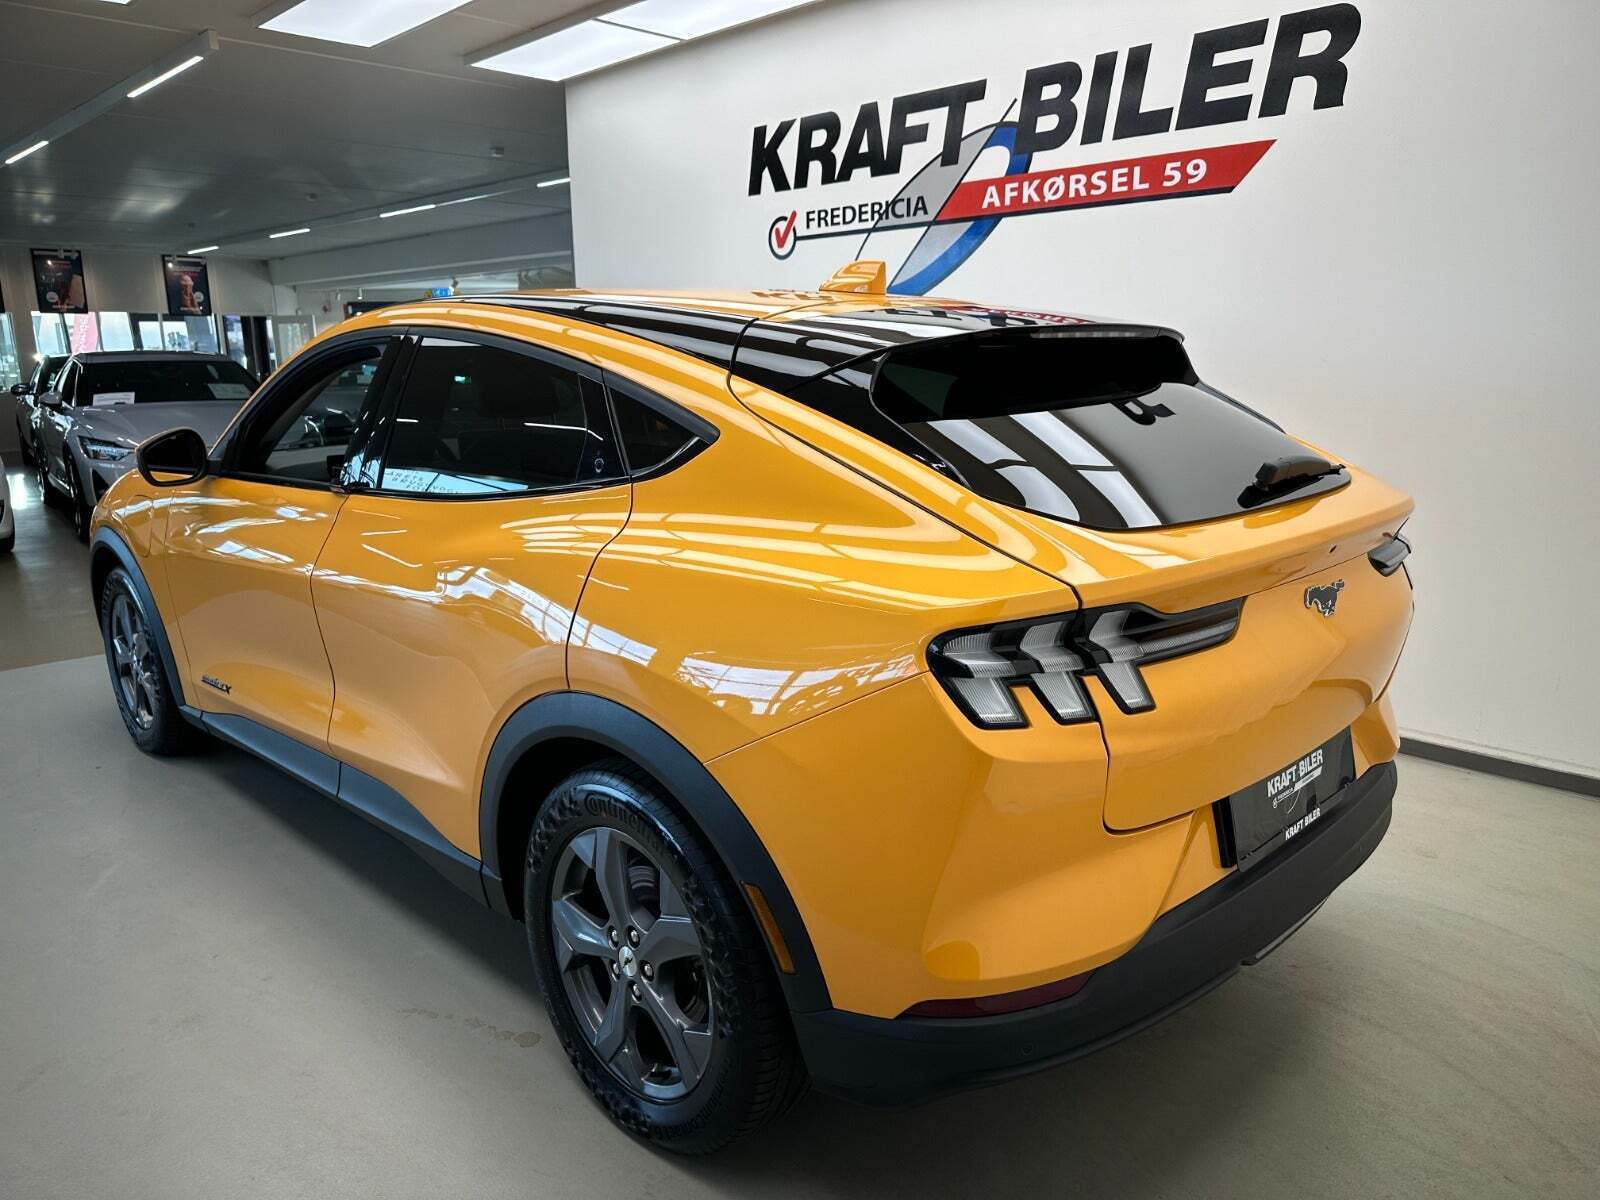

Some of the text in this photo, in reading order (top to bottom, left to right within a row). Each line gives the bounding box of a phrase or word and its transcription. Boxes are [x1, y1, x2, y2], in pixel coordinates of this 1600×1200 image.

[748, 2, 1361, 196] KRAFT BILER
[982, 158, 1207, 209] AFKØRSEL 59
[806, 196, 928, 229] FREDERICIA
[1267, 765, 1297, 798] KRAFT
[1299, 749, 1324, 778] BILER
[1285, 807, 1321, 840] KRAFT BILER
